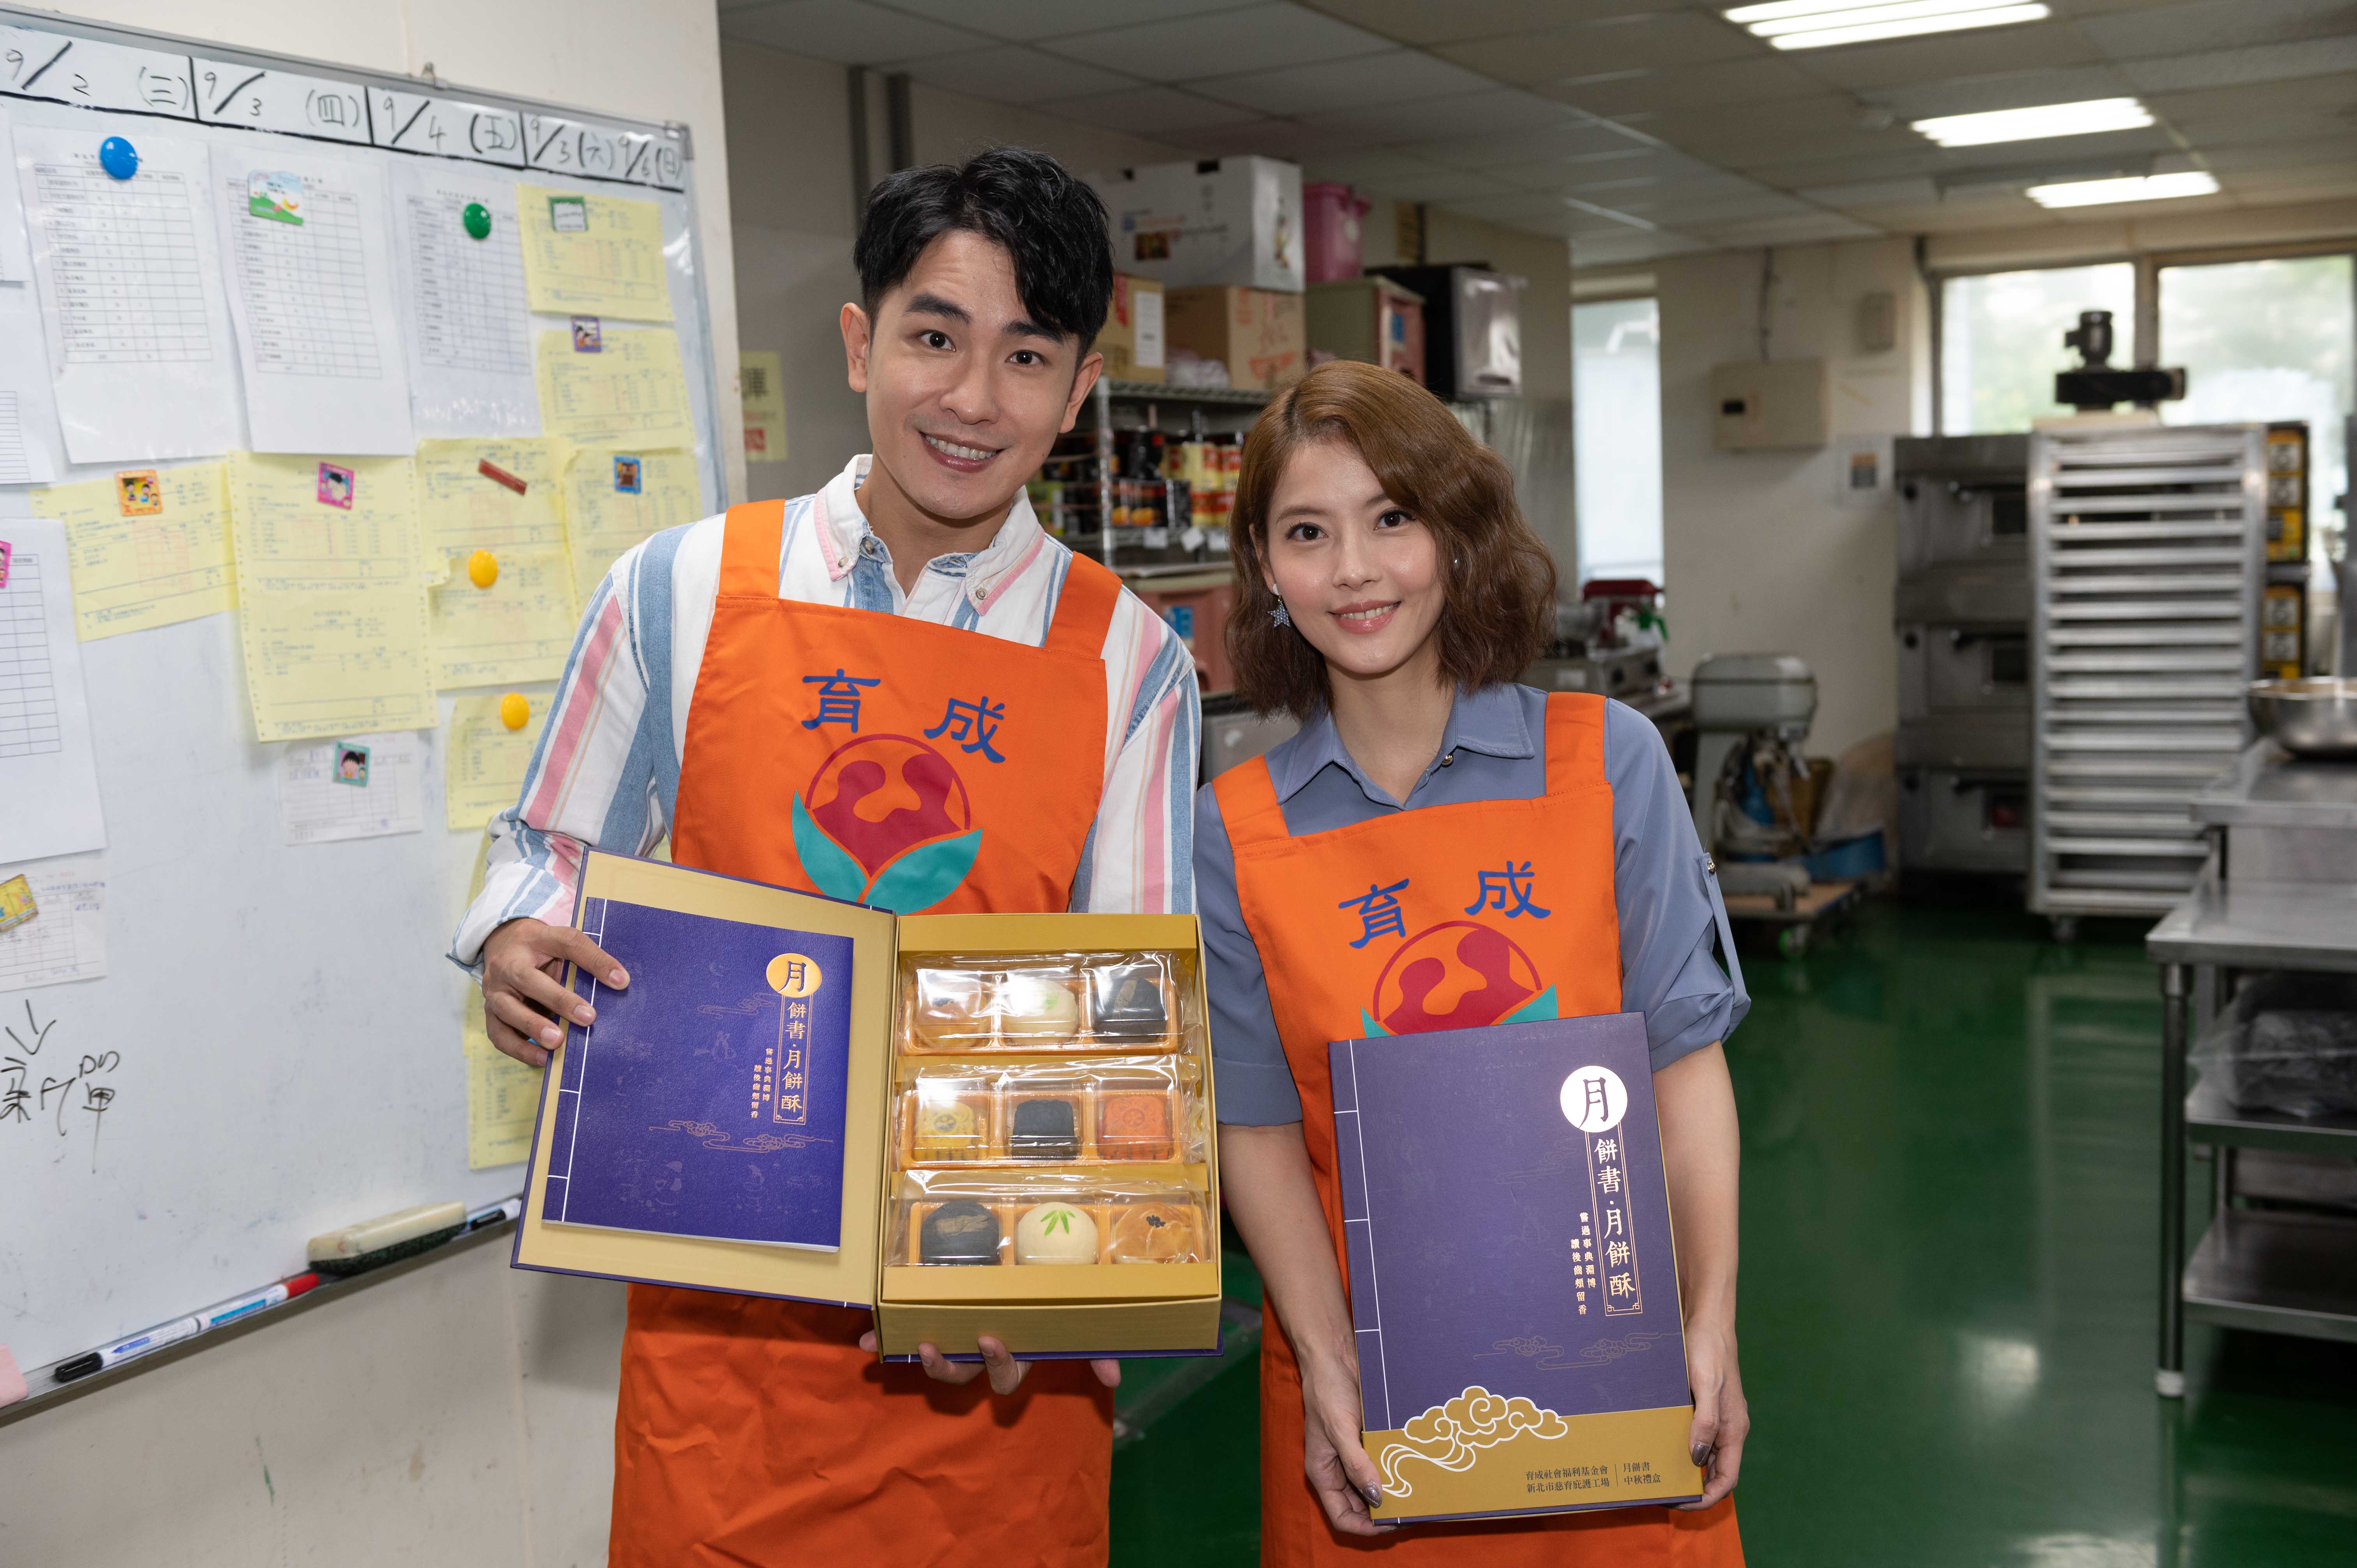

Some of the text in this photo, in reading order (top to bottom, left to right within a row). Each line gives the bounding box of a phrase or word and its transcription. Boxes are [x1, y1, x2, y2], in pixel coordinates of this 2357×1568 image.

[5, 40, 190, 112] 9/2 (三)
[204, 71, 360, 127] 9/3 (四)
[383, 96, 518, 154] 9/4 (五)
[801, 668, 1006, 763] 育成
[1338, 860, 1551, 950] 育成
[1525, 1464, 1608, 1481] 育成社會福利基金會
[1527, 1477, 1610, 1493] 新北市慈育庇護工場
[1623, 1461, 1650, 1473] 月餅書
[1624, 1473, 1661, 1485] 中秋禮盒
